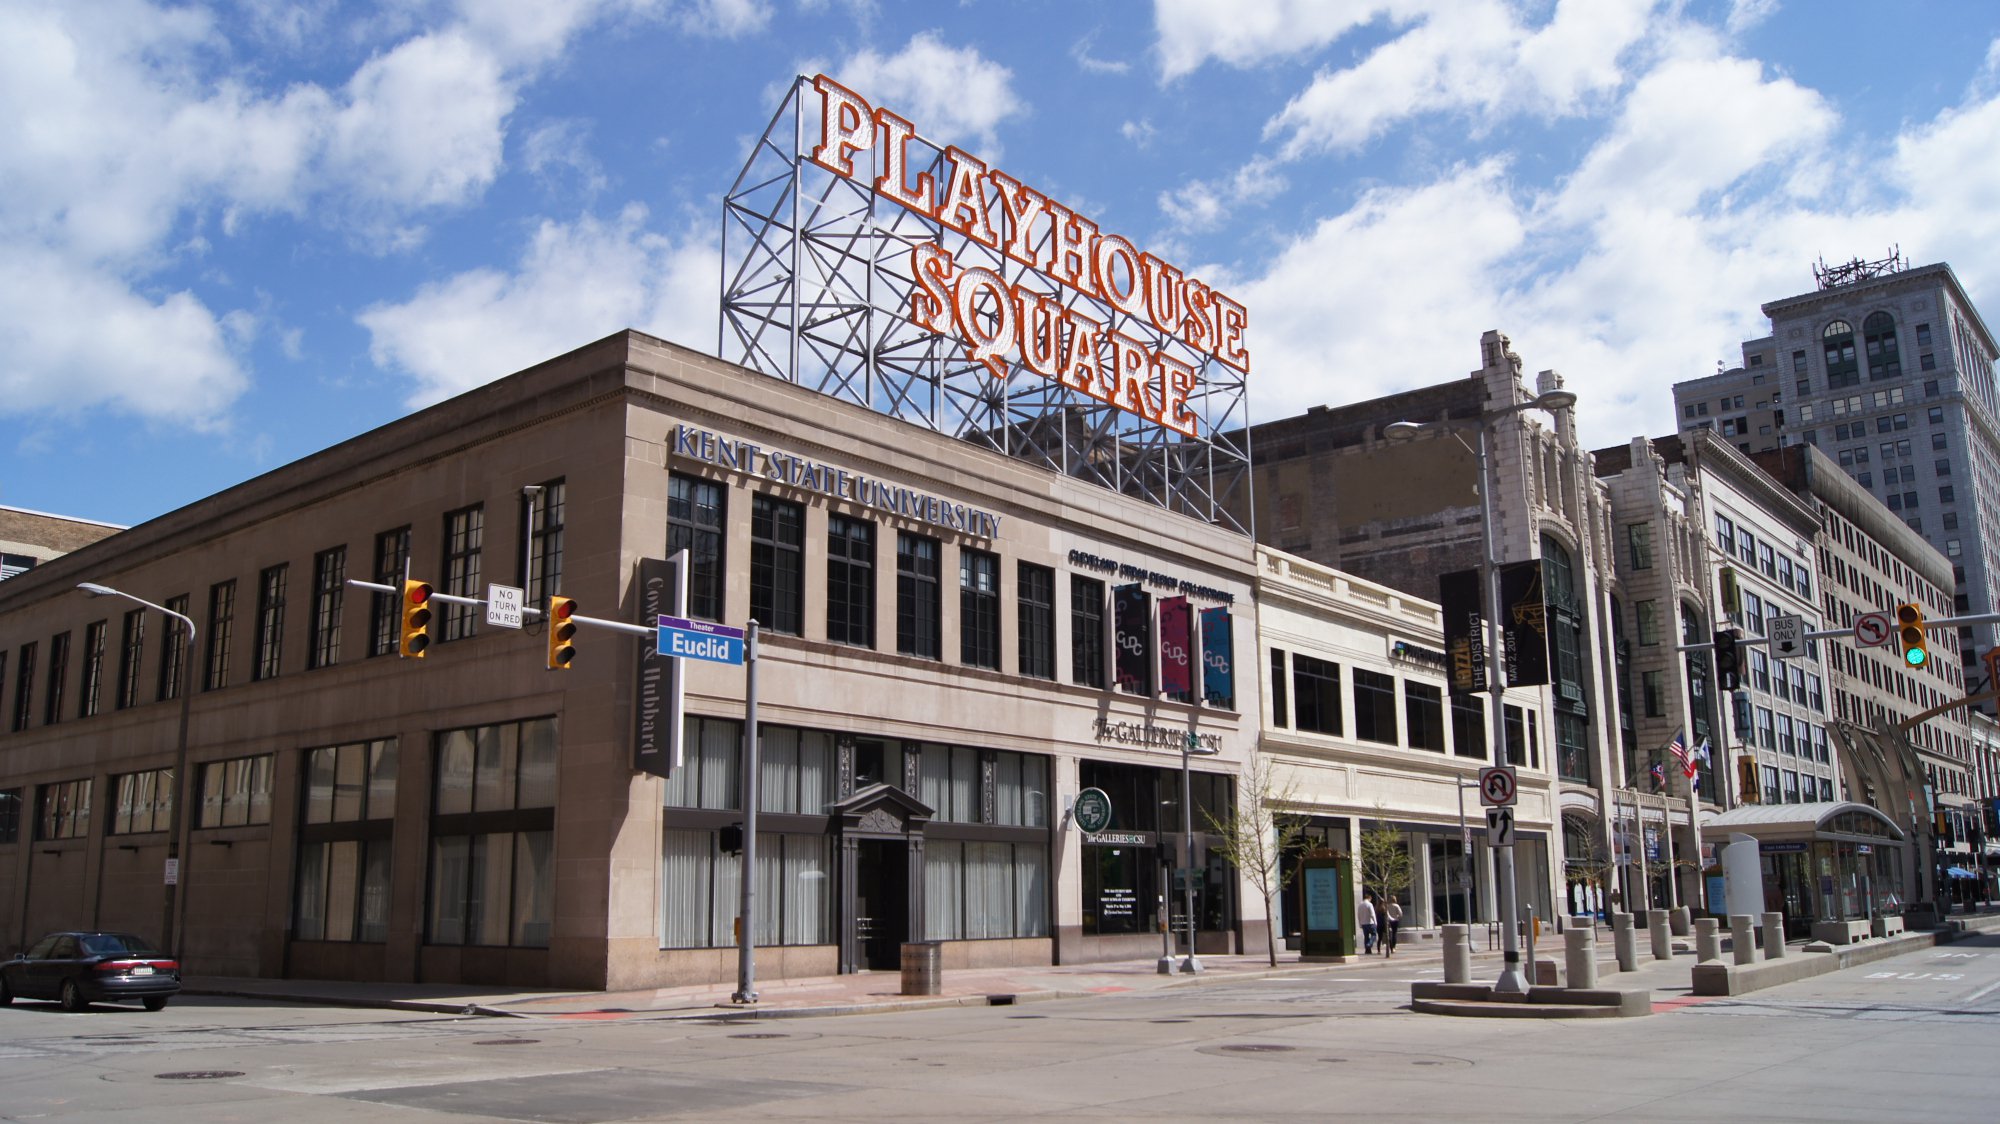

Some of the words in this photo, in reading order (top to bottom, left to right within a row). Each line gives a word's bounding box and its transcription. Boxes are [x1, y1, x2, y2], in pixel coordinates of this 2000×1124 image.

[813, 73, 1250, 374] PLAYHOUSE
[911, 241, 1199, 438] SQUARE
[672, 423, 761, 474] KENT
[767, 451, 849, 498] STATE
[855, 476, 1003, 539] UNIVERSITY
[494, 600, 517, 612] TURN
[499, 590, 513, 600] NO
[489, 611, 504, 622] ON
[504, 613, 521, 625] RED
[645, 577, 664, 640] Cowel
[689, 621, 715, 633] Theater
[1469, 611, 1483, 662] DISTRICT
[1773, 629, 1797, 642] ONLY
[1774, 619, 1794, 630] BUS
[672, 632, 730, 660] Euclid
[1116, 631, 1143, 656] CUDC
[1161, 641, 1188, 666] CUDC
[1506, 631, 1516, 652] 2014
[1203, 650, 1230, 674] CUDC
[1509, 663, 1518, 682] MAY
[1474, 664, 1484, 688] THE
[641, 667, 661, 755] Hubbard
[1096, 833, 1129, 844] GALLERIES
[1133, 834, 1146, 845] CSU
[1863, 972, 1965, 981] BUS
